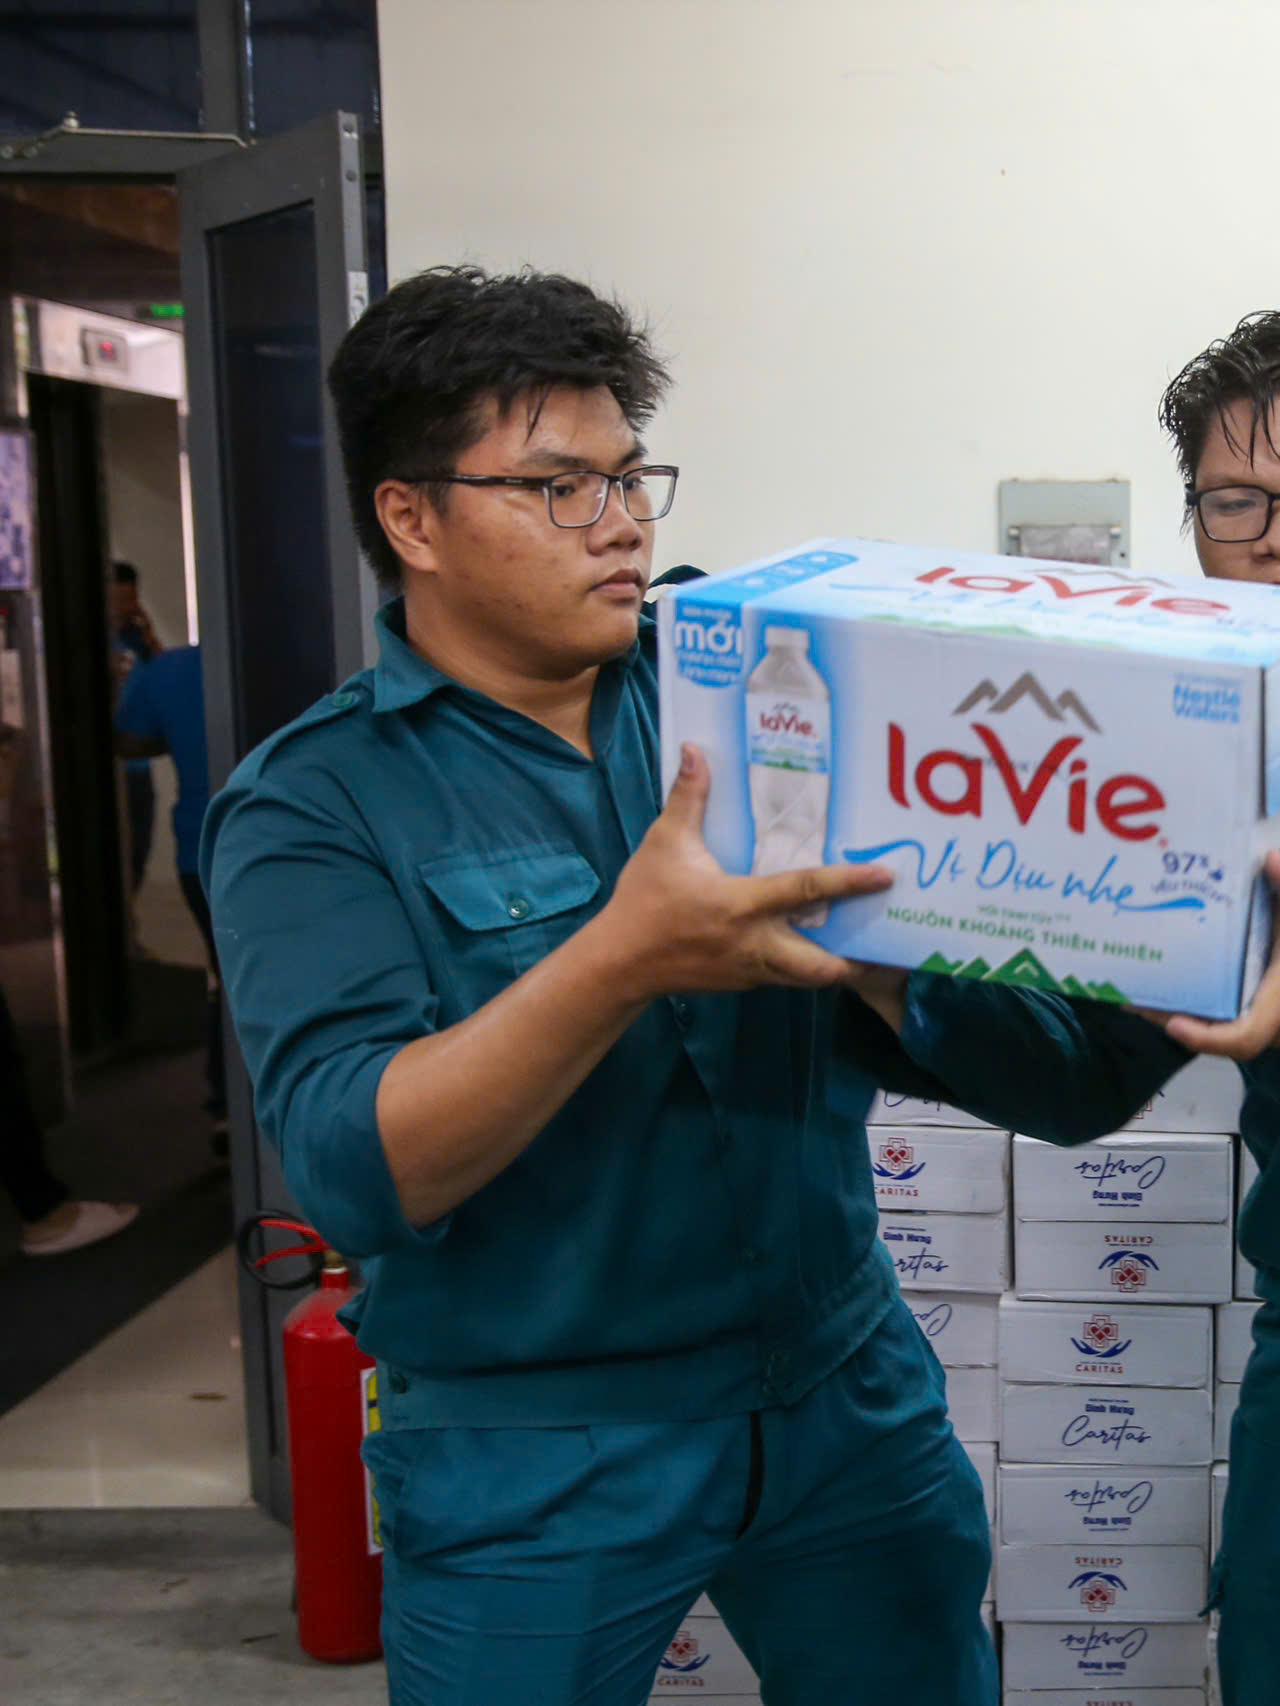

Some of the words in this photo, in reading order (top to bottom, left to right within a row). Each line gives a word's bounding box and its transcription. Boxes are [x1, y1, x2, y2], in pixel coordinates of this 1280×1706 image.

[888, 722, 1165, 842] laVie
[894, 1247, 949, 1280] ritas
[1075, 1364, 1124, 1374] CARITAS
[1062, 1414, 1152, 1451] Caritas
